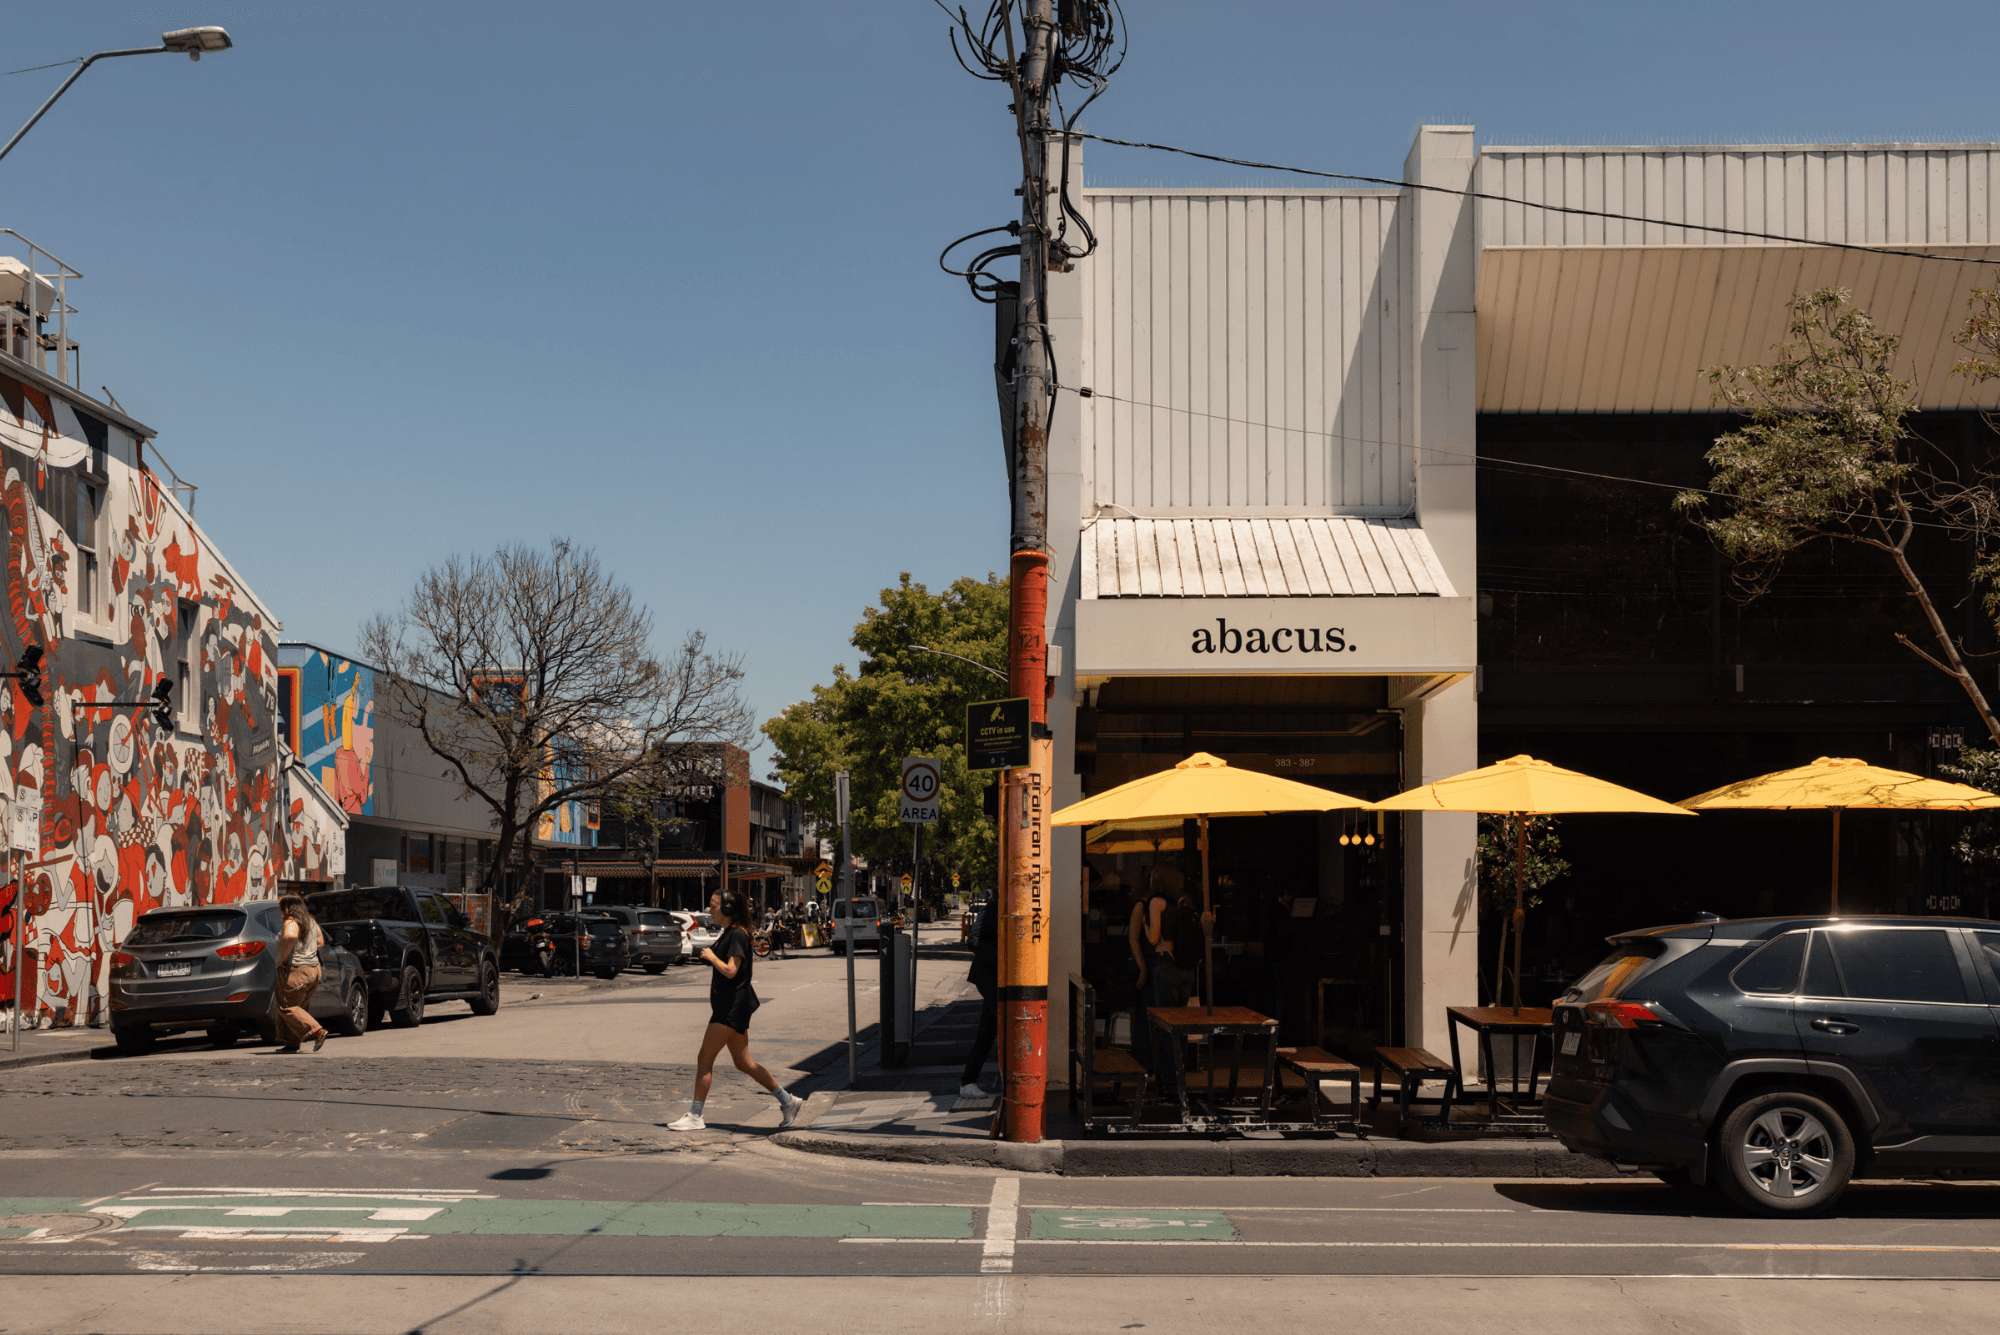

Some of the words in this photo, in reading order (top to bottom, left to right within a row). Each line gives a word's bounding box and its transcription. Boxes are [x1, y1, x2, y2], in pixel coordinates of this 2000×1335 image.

[1018, 633, 1040, 648] 121
[1191, 617, 1357, 654] abacus.
[265, 691, 275, 710] 78
[980, 726, 996, 736] CCTV
[996, 726, 1004, 734] in
[1004, 726, 1016, 734] use
[1275, 758, 1291, 767] 383
[1298, 758, 1315, 767] 387
[908, 774, 934, 792] 40
[901, 807, 938, 820] AREA
[1029, 772, 1042, 858] prahran
[1031, 864, 1042, 943] market
